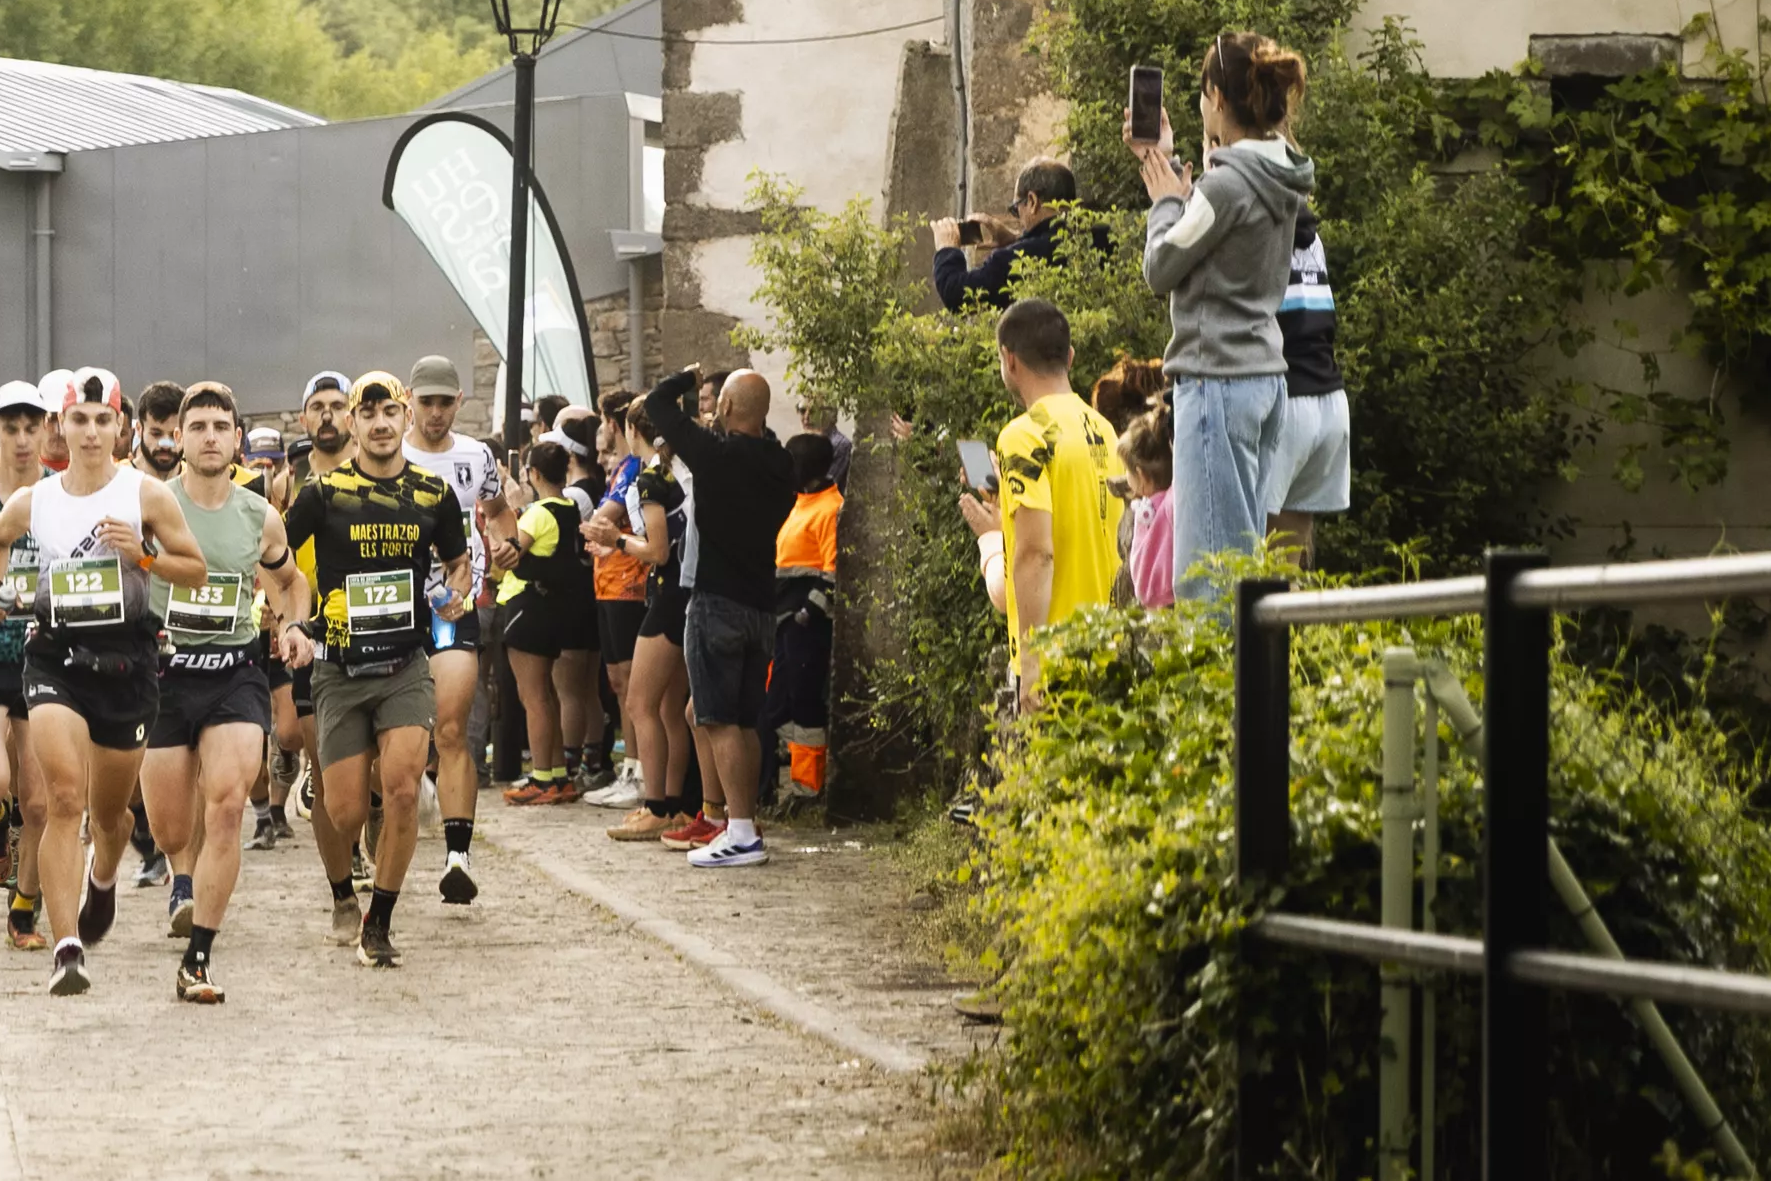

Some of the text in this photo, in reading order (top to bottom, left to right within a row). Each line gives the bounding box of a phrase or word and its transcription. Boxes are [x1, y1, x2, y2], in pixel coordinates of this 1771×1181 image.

[350, 523, 420, 542] MAESTRAZGO
[360, 542, 377, 558] ELS
[66, 572, 103, 593] 122
[190, 586, 224, 604] 133
[363, 584, 398, 604] 172
[169, 652, 234, 670] FUGA
